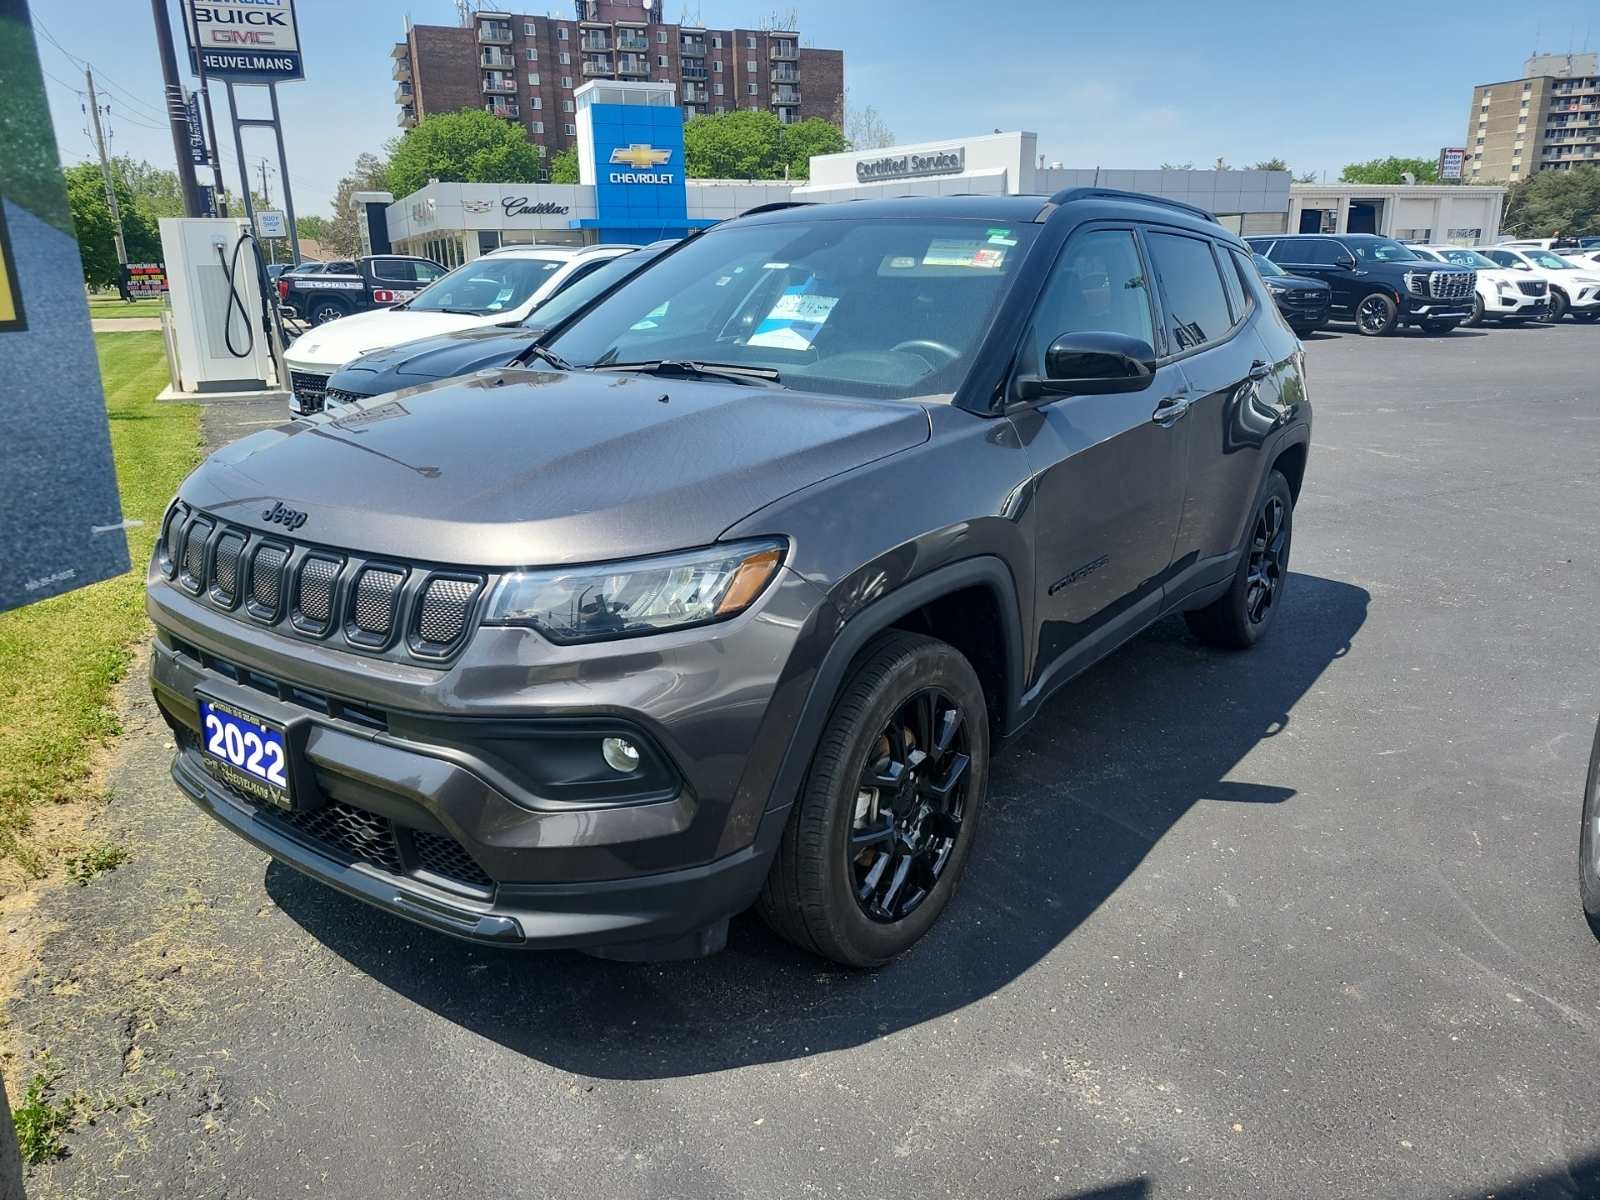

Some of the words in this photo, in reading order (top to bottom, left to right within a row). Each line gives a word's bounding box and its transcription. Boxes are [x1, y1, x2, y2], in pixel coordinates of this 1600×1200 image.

[195, 8, 288, 26] BUICK
[211, 29, 275, 45] GMC
[856, 156, 907, 176] Certified
[911, 152, 958, 170] Service
[609, 172, 674, 184] CHEVROLET
[501, 196, 569, 217] Cadillac
[1451, 256, 1474, 265] SOLD
[261, 501, 308, 531] Jeep
[206, 714, 287, 788] 2022
